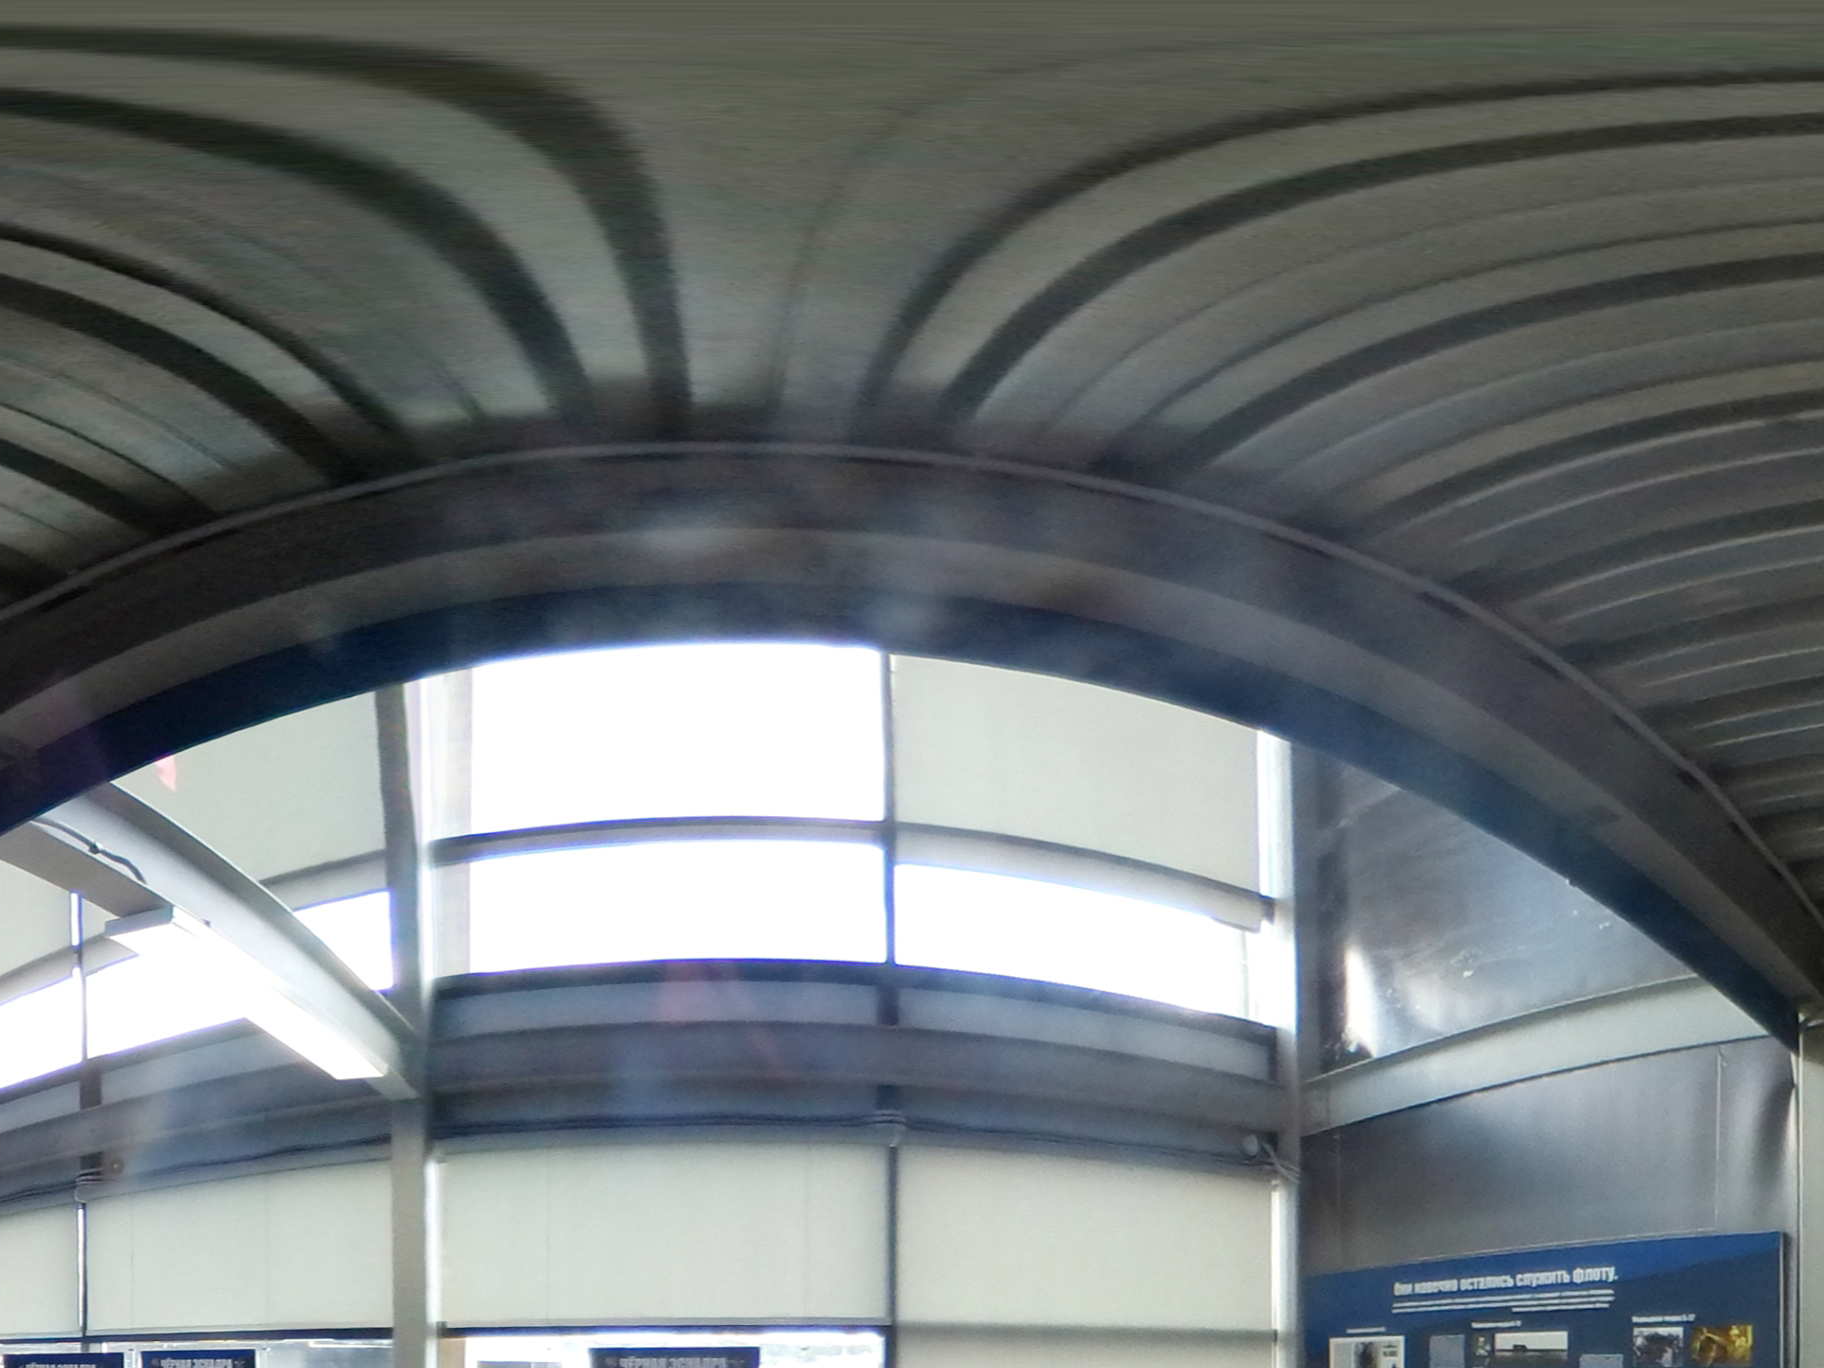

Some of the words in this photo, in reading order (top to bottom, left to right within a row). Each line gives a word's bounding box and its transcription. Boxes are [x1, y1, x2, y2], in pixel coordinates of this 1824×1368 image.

[1460, 1274, 1514, 1291] остались
[1515, 1269, 1571, 1287] служить
[1572, 1265, 1619, 1285] флоту.
